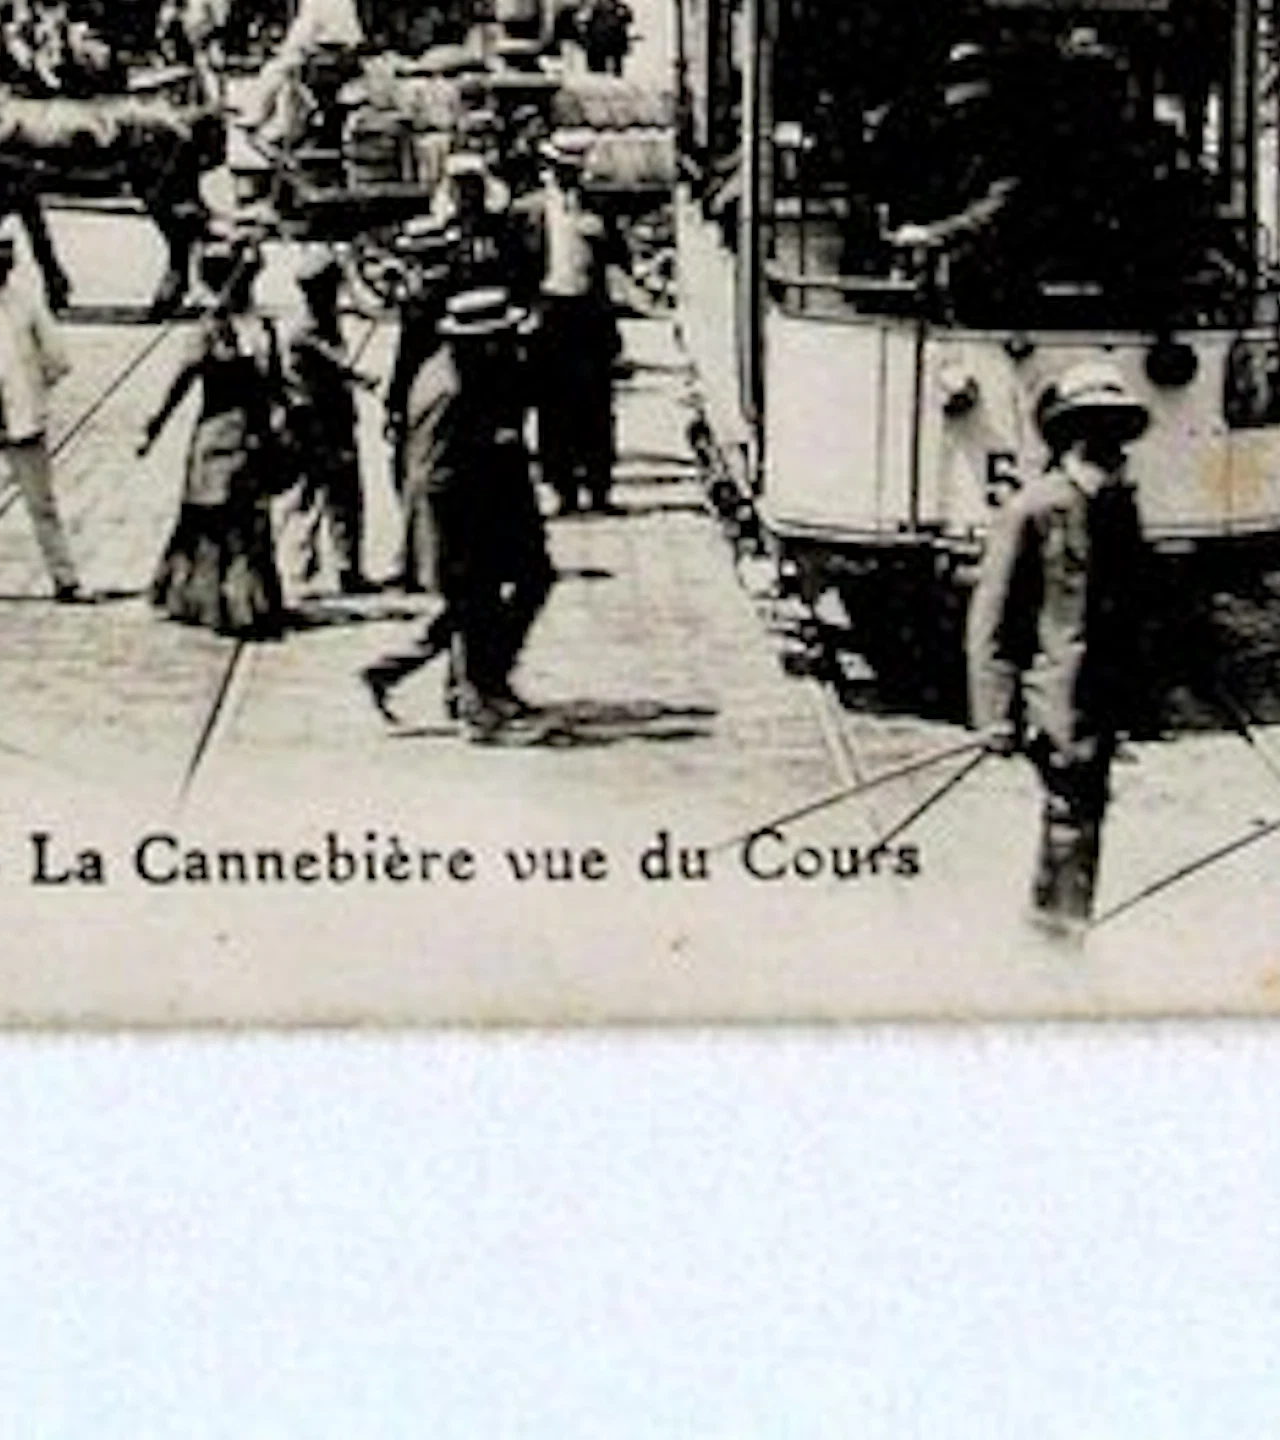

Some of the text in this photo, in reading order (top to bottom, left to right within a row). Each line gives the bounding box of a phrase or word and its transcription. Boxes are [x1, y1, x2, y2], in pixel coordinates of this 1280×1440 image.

[28, 831, 106, 886] La
[133, 830, 476, 886] Cannebière
[505, 847, 609, 883] vue
[638, 829, 711, 882] du
[740, 826, 923, 881] Cours
